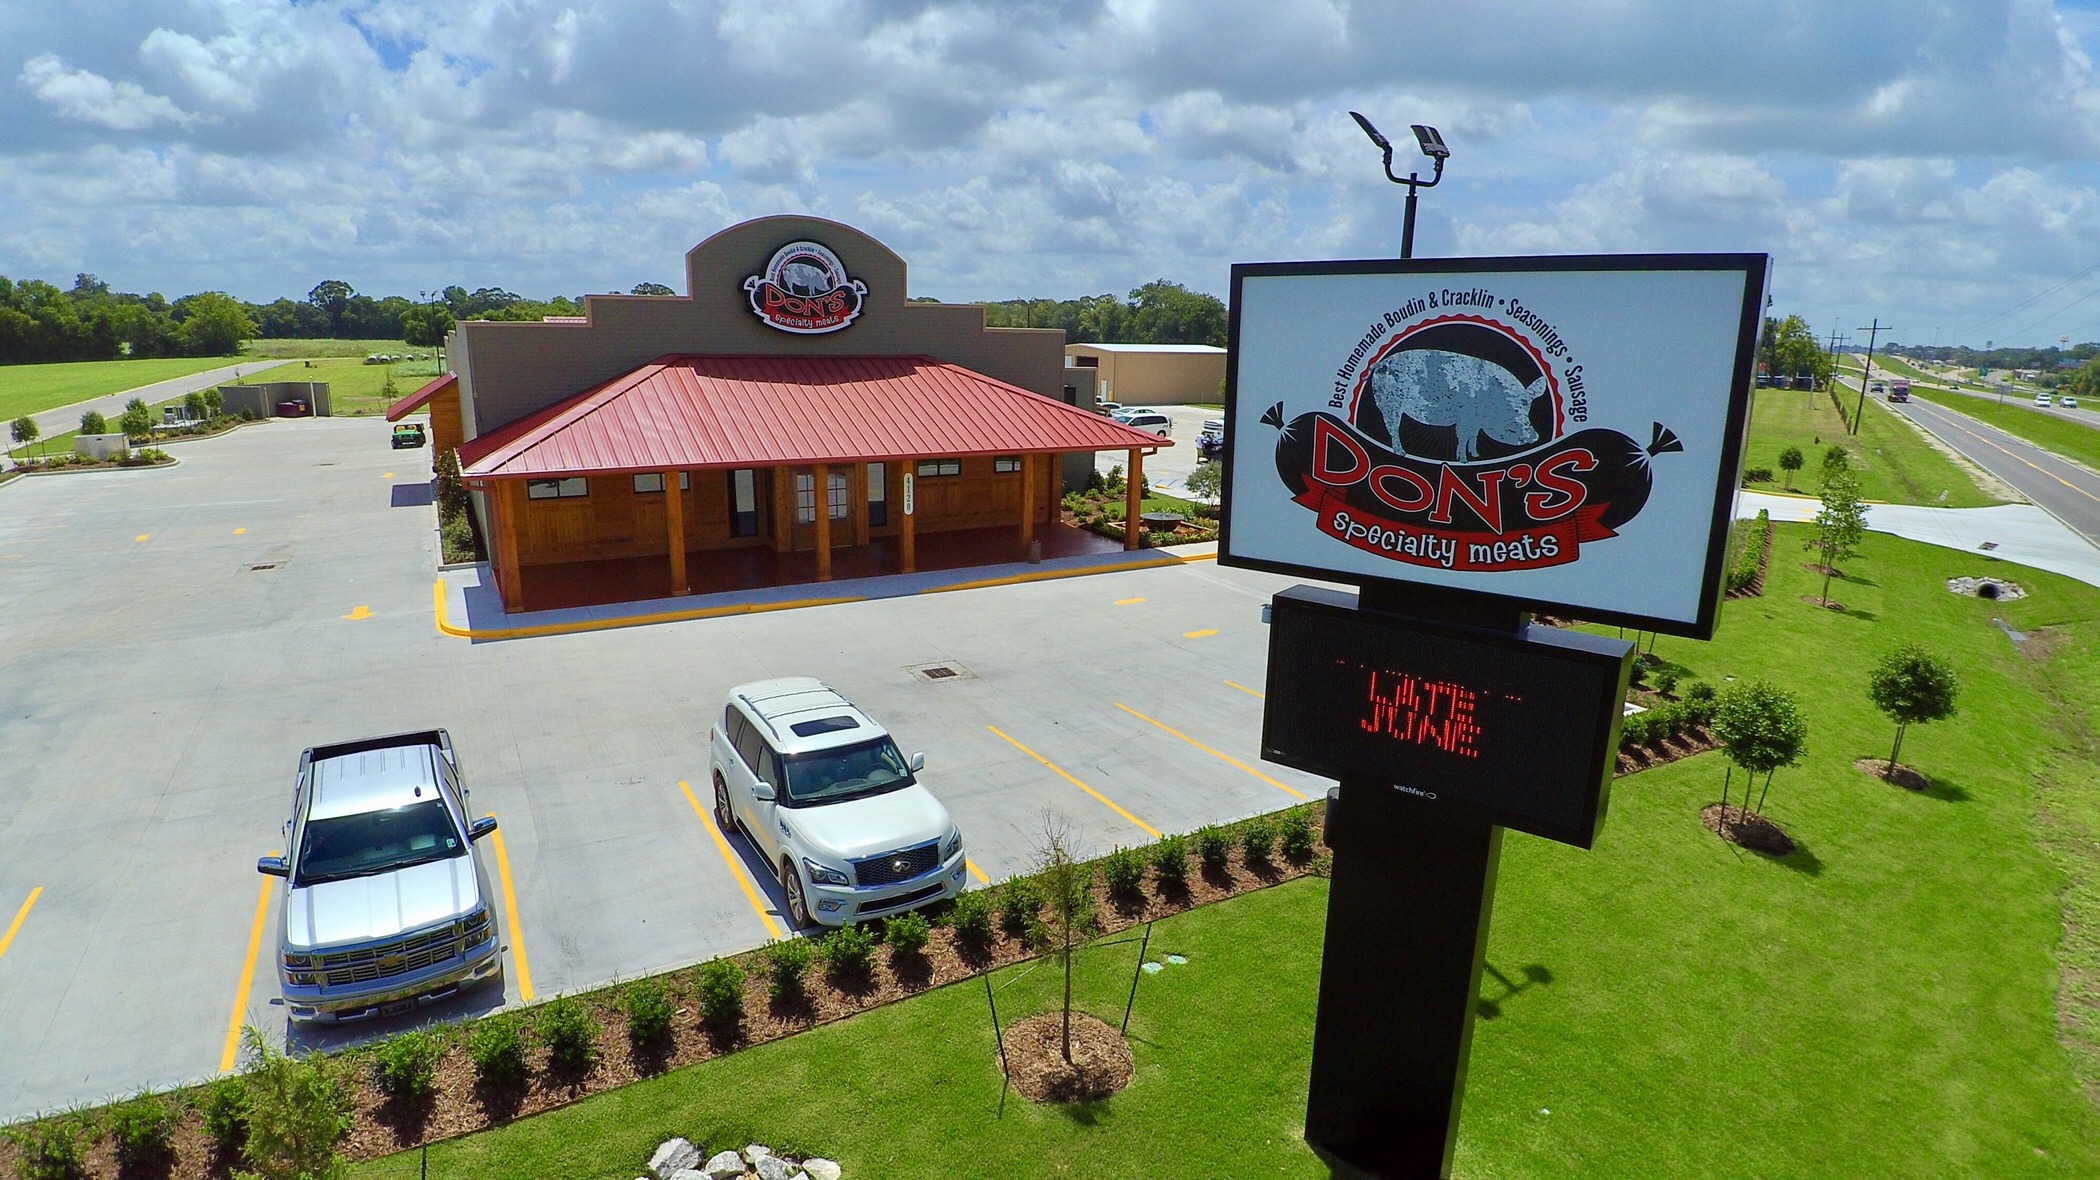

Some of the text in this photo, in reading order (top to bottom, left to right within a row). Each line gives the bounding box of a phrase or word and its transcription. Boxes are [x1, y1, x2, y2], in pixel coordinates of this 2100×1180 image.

[765, 283, 846, 317] DON'S
[1328, 288, 1588, 422] Best Homemade Boudin & Cracklin Seasonings Sausage
[1311, 412, 1600, 535] DON'S
[1468, 533, 1560, 565] meats
[1393, 784, 1424, 797] watchfire
